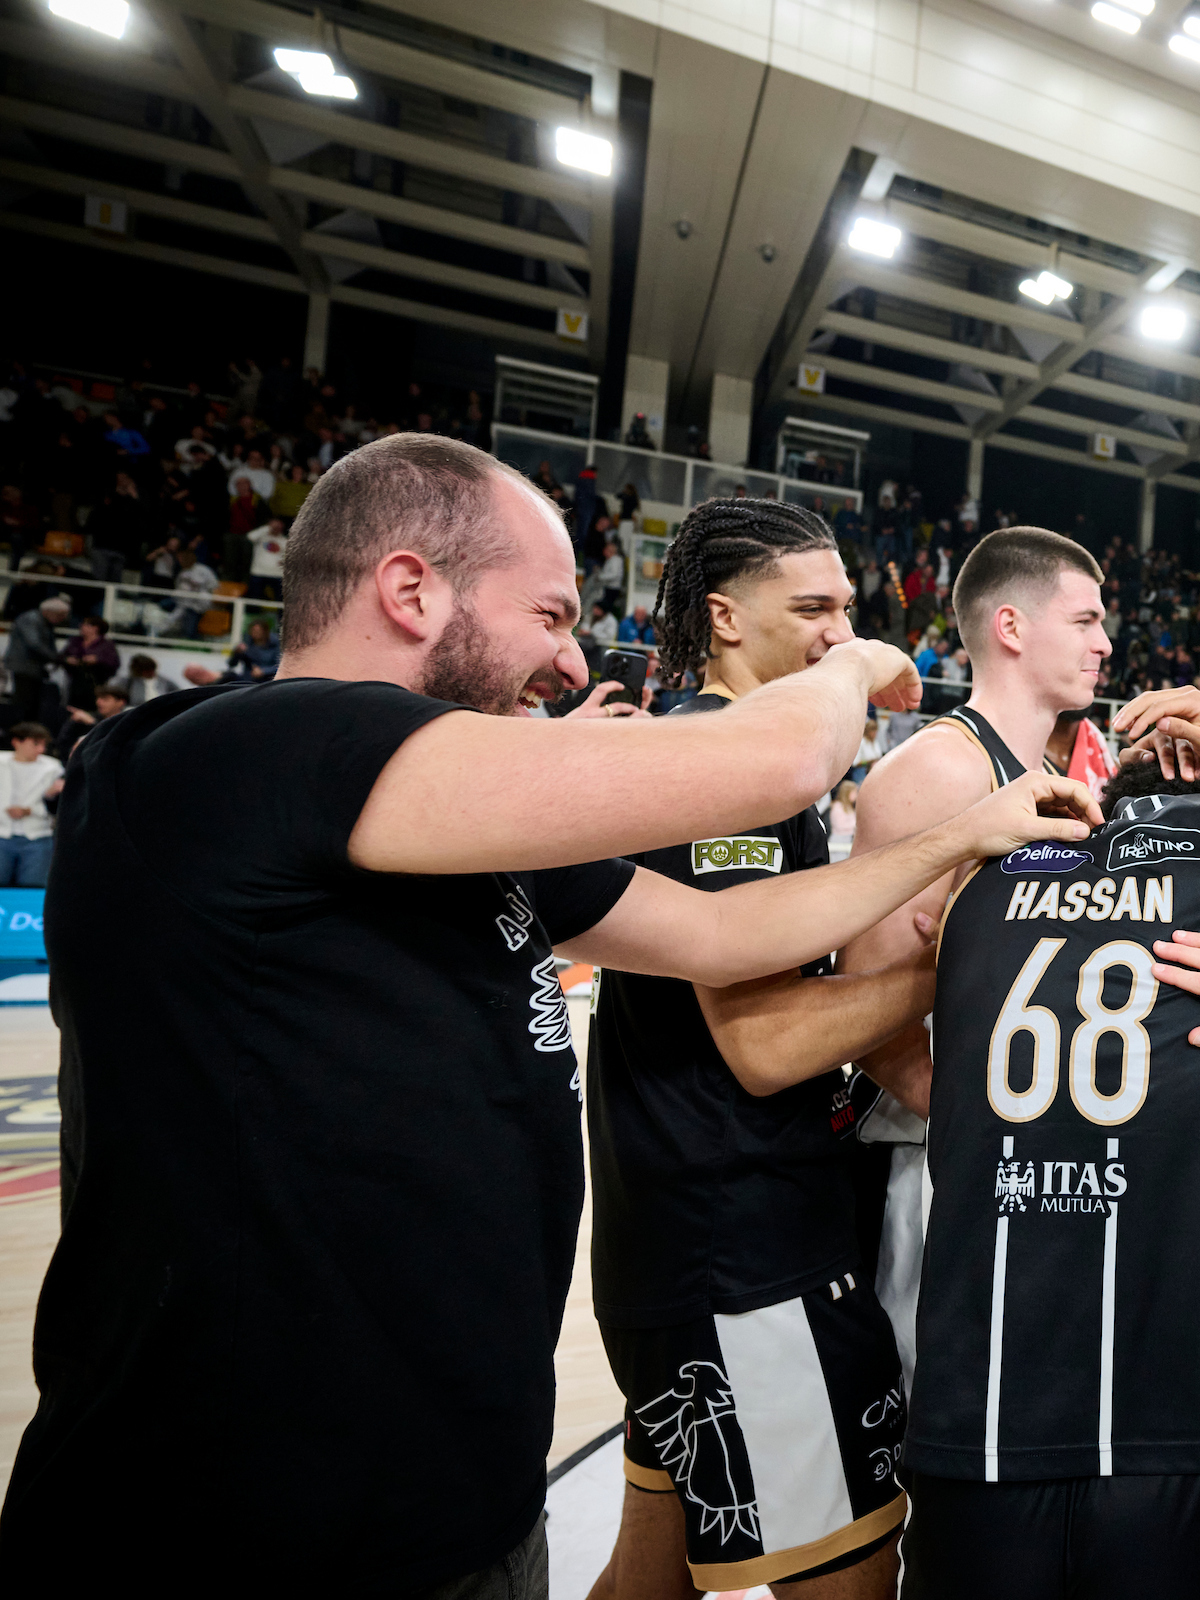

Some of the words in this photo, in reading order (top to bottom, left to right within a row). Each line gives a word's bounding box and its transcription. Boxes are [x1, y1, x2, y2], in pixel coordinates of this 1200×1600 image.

[694, 840, 781, 869] FORST
[1118, 839, 1195, 859] TRENTINO
[1004, 874, 1173, 923] HASSAN
[987, 937, 1160, 1126] 68
[1040, 1161, 1128, 1197] ITAS
[1040, 1198, 1106, 1214] MUTUA
